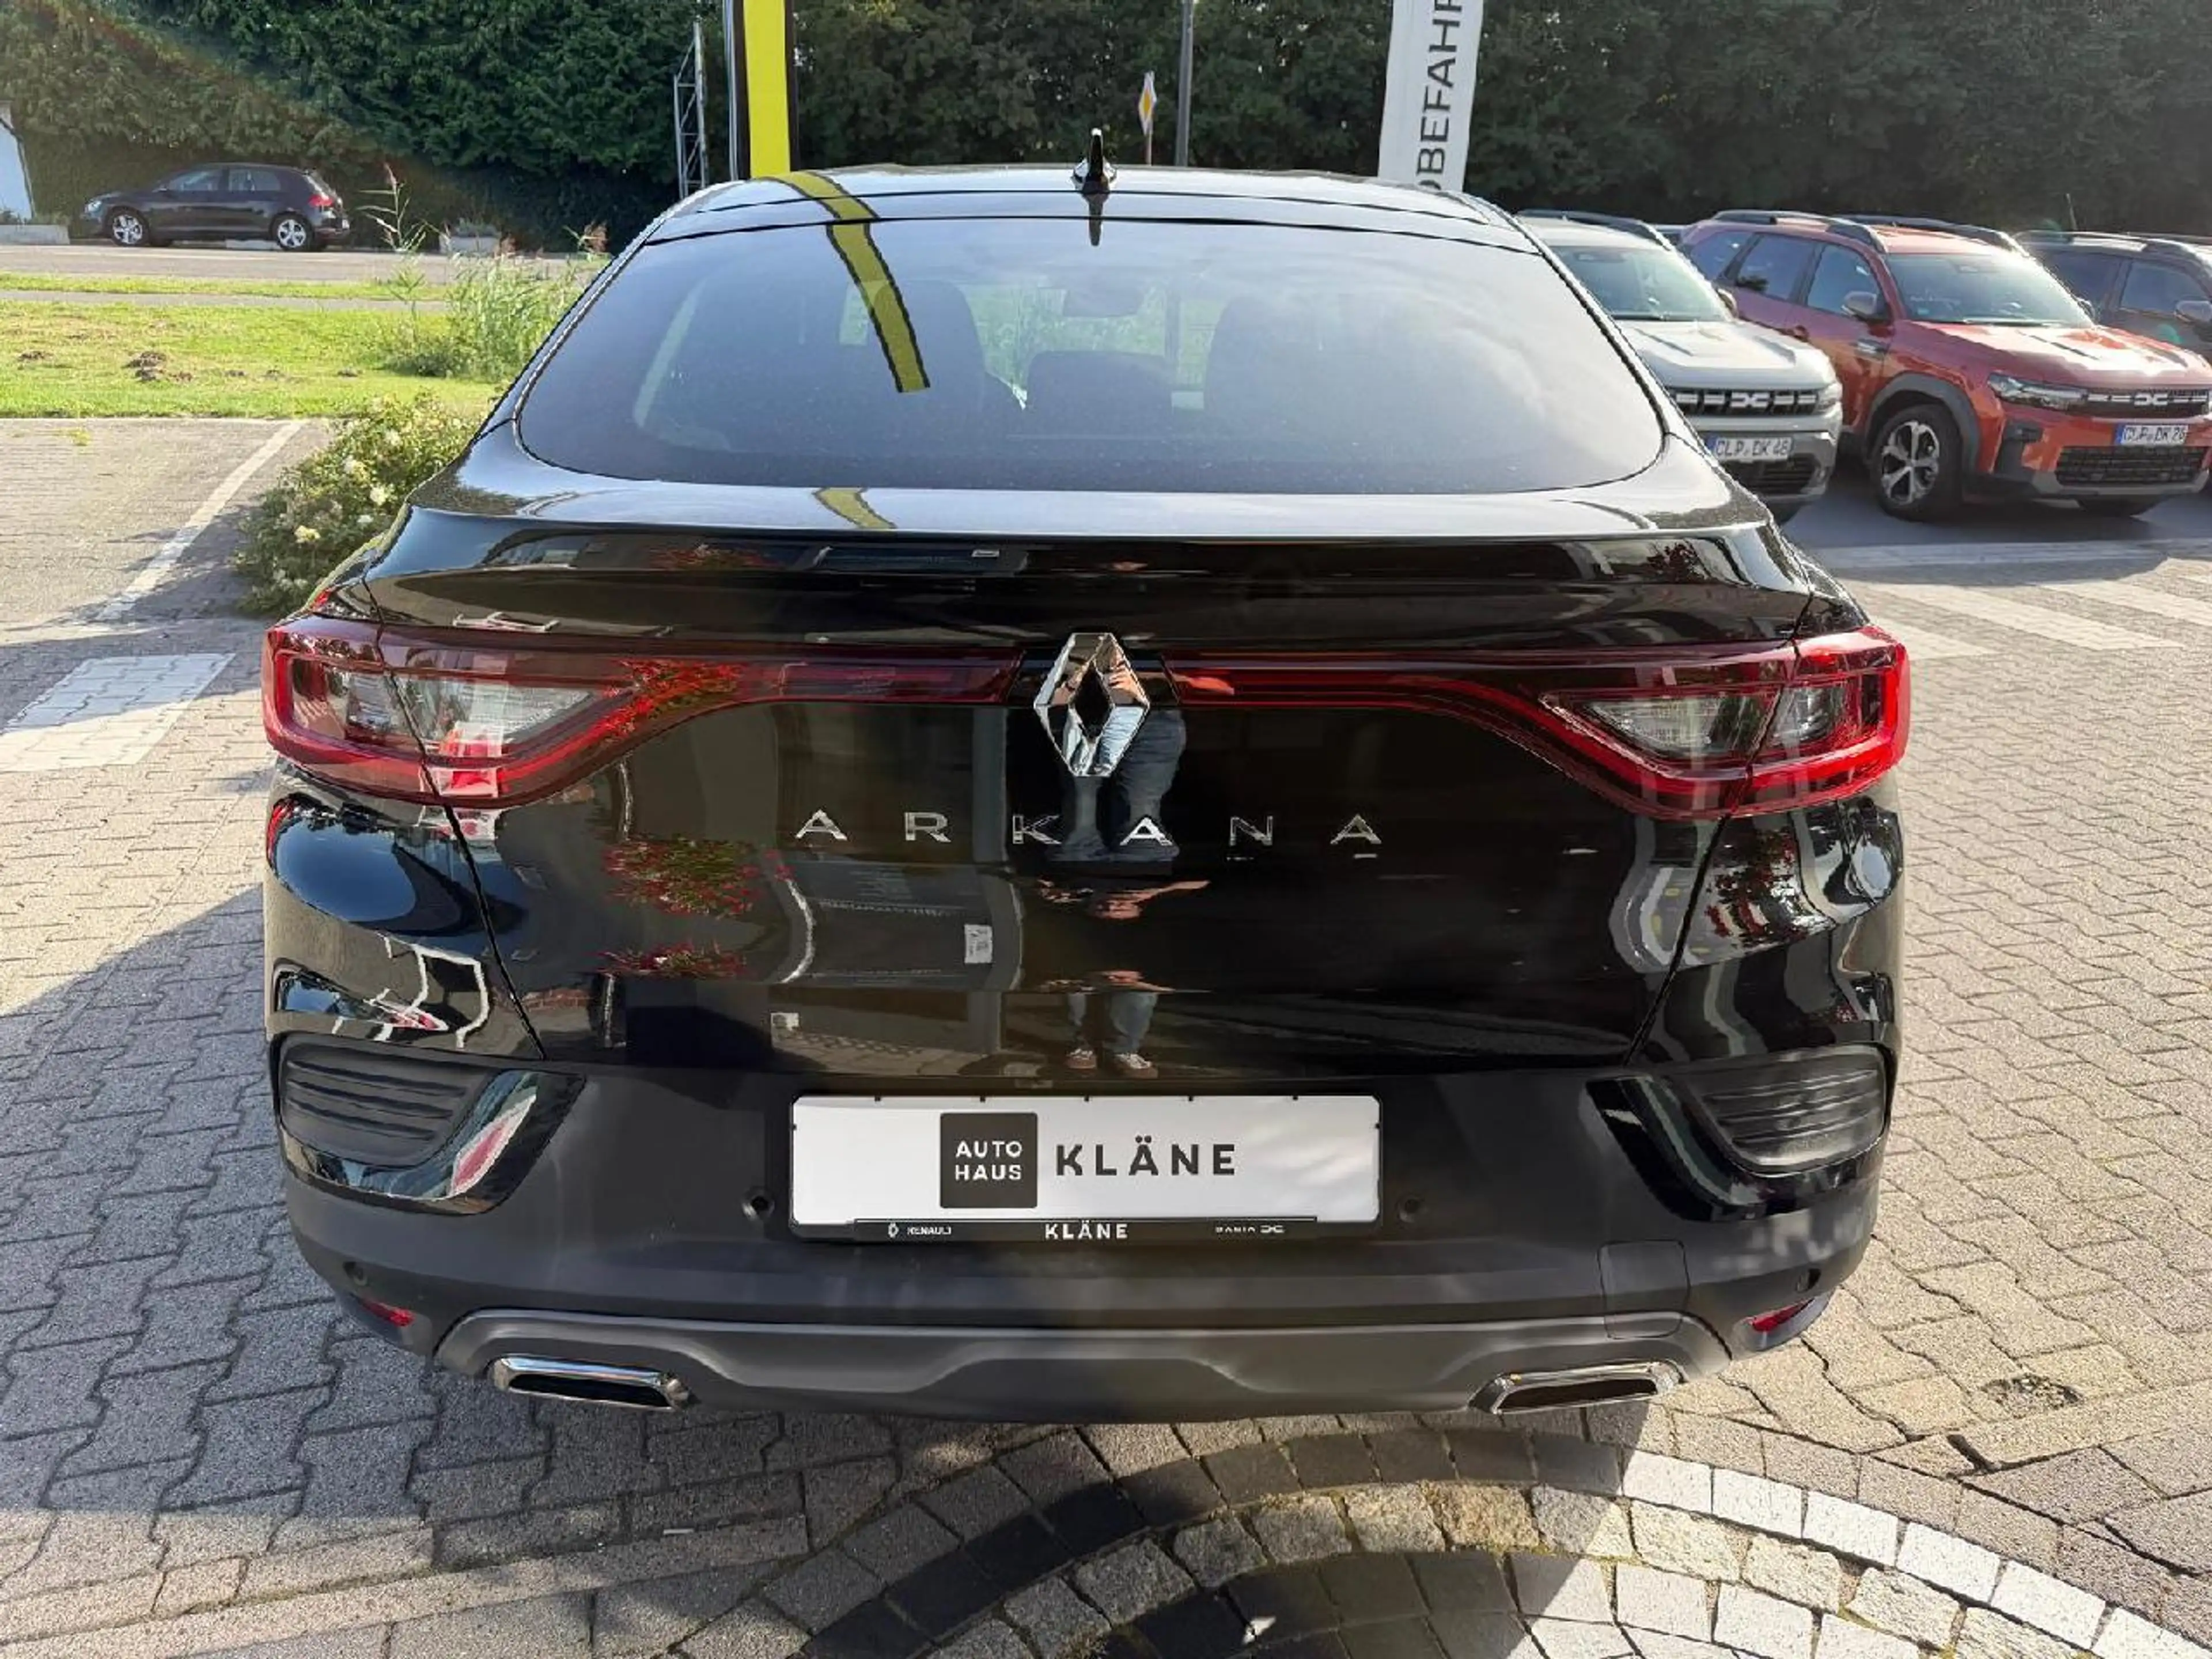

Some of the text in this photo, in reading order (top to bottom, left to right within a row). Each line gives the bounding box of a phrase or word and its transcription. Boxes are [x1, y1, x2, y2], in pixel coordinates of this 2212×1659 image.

[795, 809, 1382, 846] ARKANA
[955, 1140, 1023, 1158] AUTO
[1056, 1135, 1236, 1176] KLÄNE
[955, 1164, 1022, 1181] HAUS
[1044, 1219, 1128, 1240] KLÄNE
